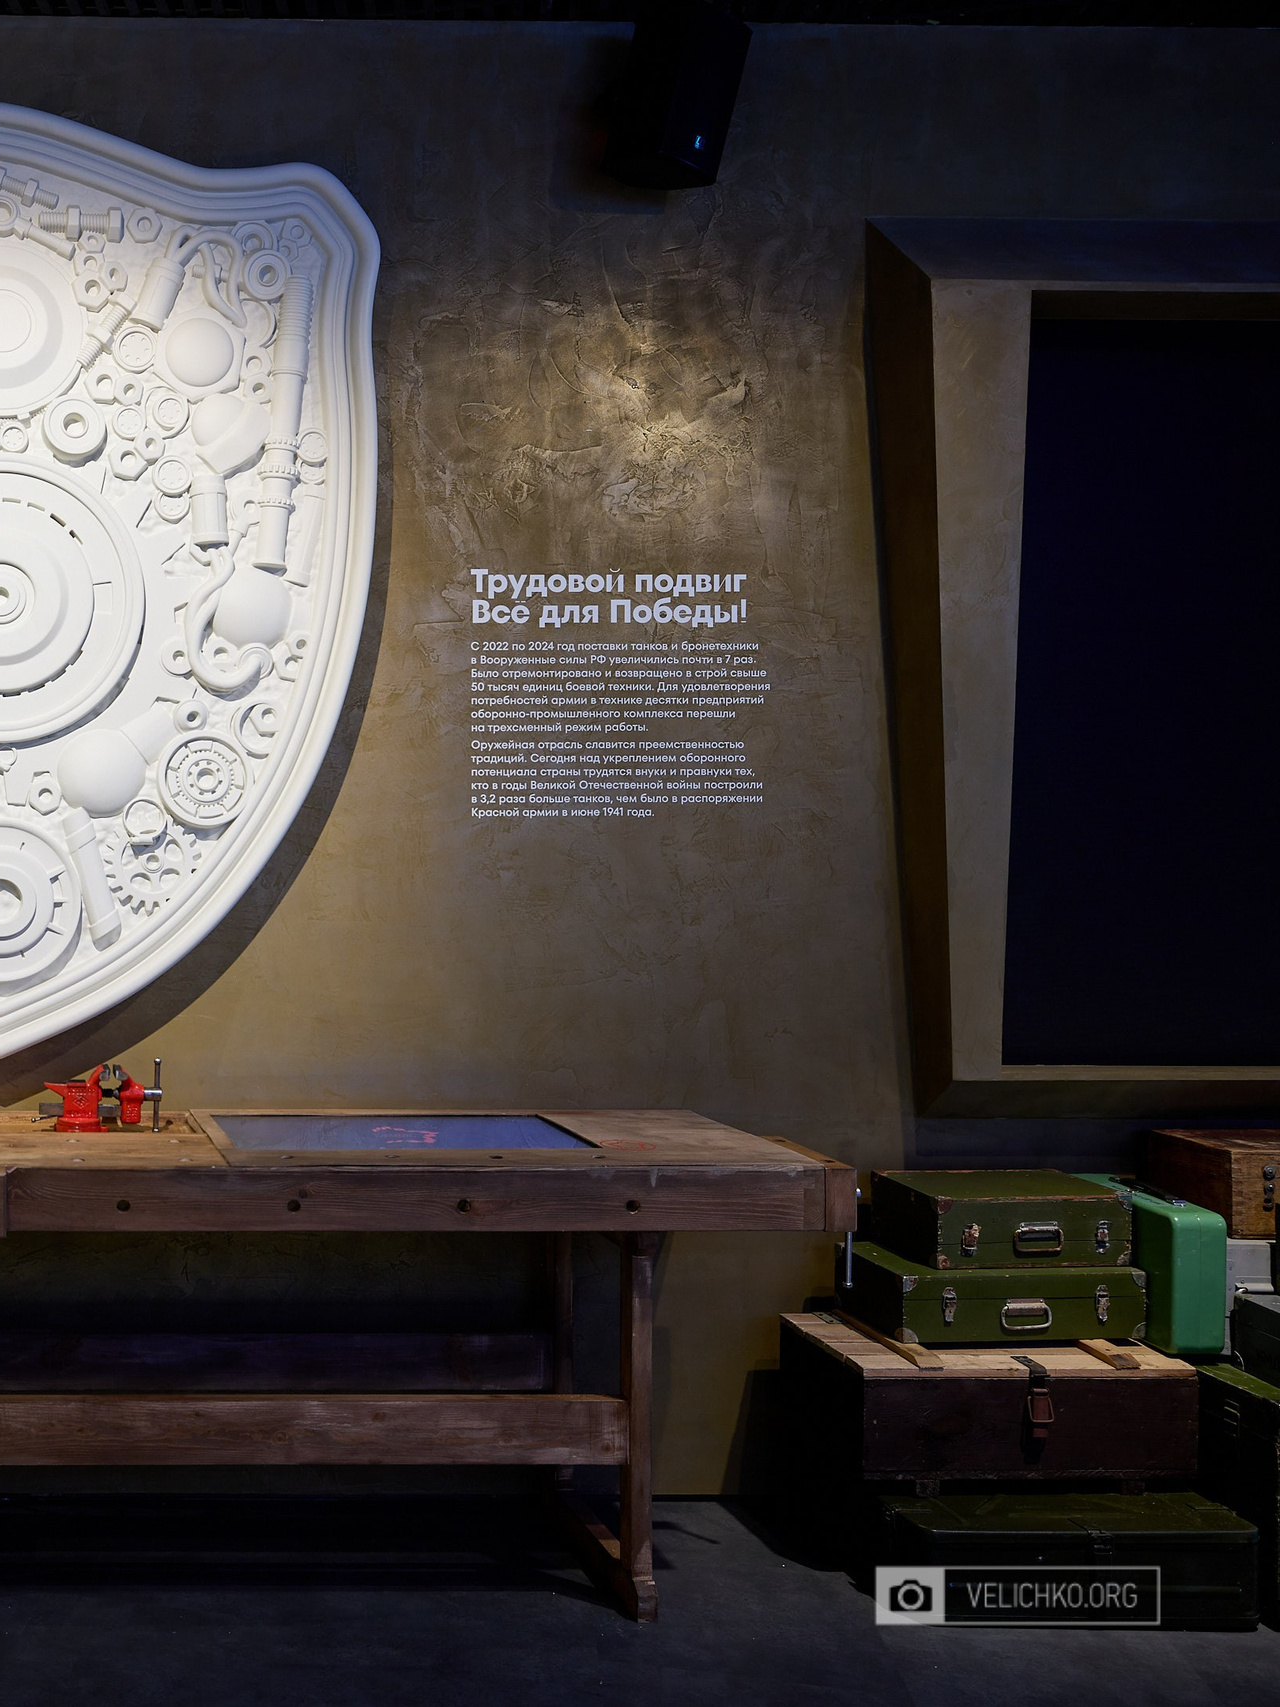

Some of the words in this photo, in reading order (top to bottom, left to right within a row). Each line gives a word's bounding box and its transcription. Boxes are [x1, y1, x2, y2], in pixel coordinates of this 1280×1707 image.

[470, 568, 624, 598] Трудовой
[635, 574, 747, 598] подвиг
[472, 599, 530, 624] Всё
[539, 605, 598, 628] для
[611, 598, 746, 627] Победы!
[470, 641, 480, 651] С
[483, 641, 509, 651] 2022
[528, 641, 554, 650] 2024
[557, 644, 575, 652] год
[681, 641, 758, 652] бронетехники
[480, 655, 556, 666] Вооруженные
[591, 655, 606, 664] РФ
[609, 657, 679, 666] увеличились
[725, 655, 731, 663] 7
[734, 657, 756, 666] раз.
[471, 668, 499, 678] Было
[502, 670, 602, 680] отремонтировано
[615, 670, 683, 679] возвращено
[695, 668, 727, 679] строй
[471, 682, 485, 691] 50
[522, 684, 563, 692] единиц
[566, 682, 605, 691] боевой
[657, 682, 678, 692] Для
[681, 684, 770, 693] удовлетворения
[471, 695, 548, 707] потребностей
[551, 697, 587, 706] армии
[645, 697, 688, 706] десятки
[692, 695, 764, 706] предприятий
[471, 709, 620, 720] оборонно-промышленного
[687, 711, 735, 720] перешли
[487, 722, 562, 734] трехсменный
[565, 724, 601, 733] режим
[605, 722, 648, 733] работы.
[471, 740, 535, 751] Оружейная
[538, 742, 583, 751] отрасль
[639, 742, 744, 751] преемственностью
[471, 753, 527, 765] традиций.
[530, 753, 576, 764] Сегодня
[580, 755, 600, 764] над
[603, 755, 676, 764] укреплением
[680, 753, 746, 764] оборонного
[471, 769, 537, 777] потенциала
[540, 769, 581, 778] страны
[583, 769, 632, 778] трудятся
[635, 769, 666, 778] внуки
[680, 769, 732, 778] правнуки
[501, 783, 527, 791] годы
[531, 780, 575, 790] Великой
[579, 780, 663, 789] Отечественной
[667, 780, 700, 789] войны
[704, 782, 763, 791] построили
[480, 794, 496, 804] 3,2
[499, 796, 525, 805] раза
[529, 794, 570, 803] больше
[573, 796, 613, 804] танков,
[640, 793, 668, 803] было
[681, 796, 763, 805] распоряжении
[471, 807, 519, 819] Красной
[522, 810, 558, 819] армии
[603, 807, 623, 816] 1941
[627, 809, 654, 818] года.
